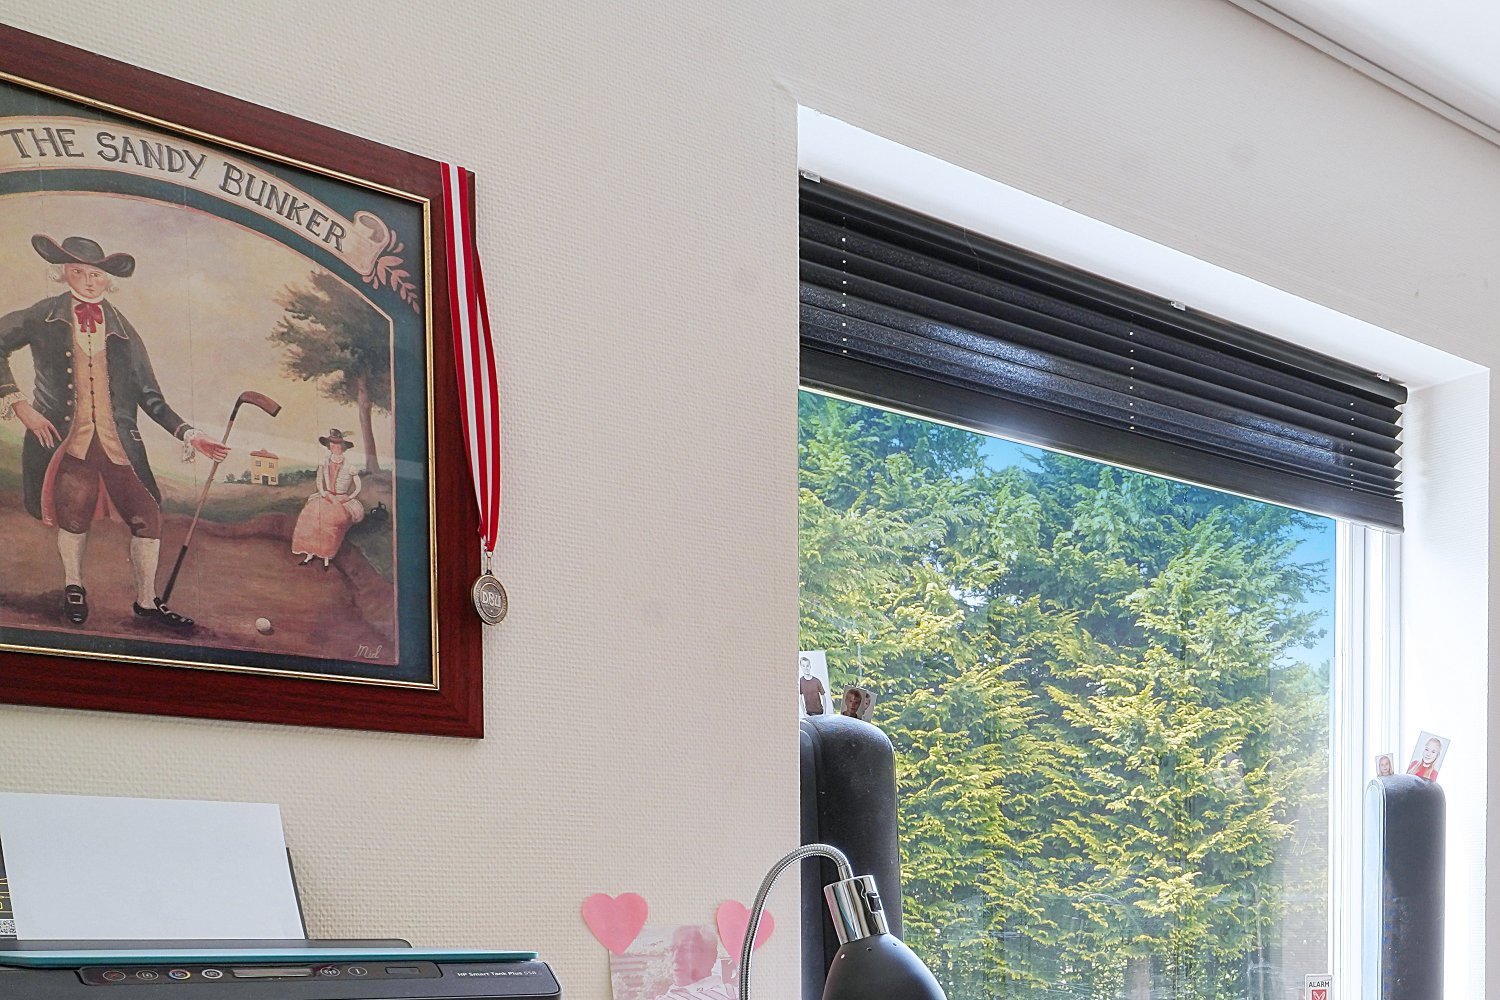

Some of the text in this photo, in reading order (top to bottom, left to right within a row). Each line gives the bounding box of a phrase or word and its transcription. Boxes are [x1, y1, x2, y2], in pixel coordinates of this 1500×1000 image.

[0, 128, 348, 254] THE SANDY BUNKER
